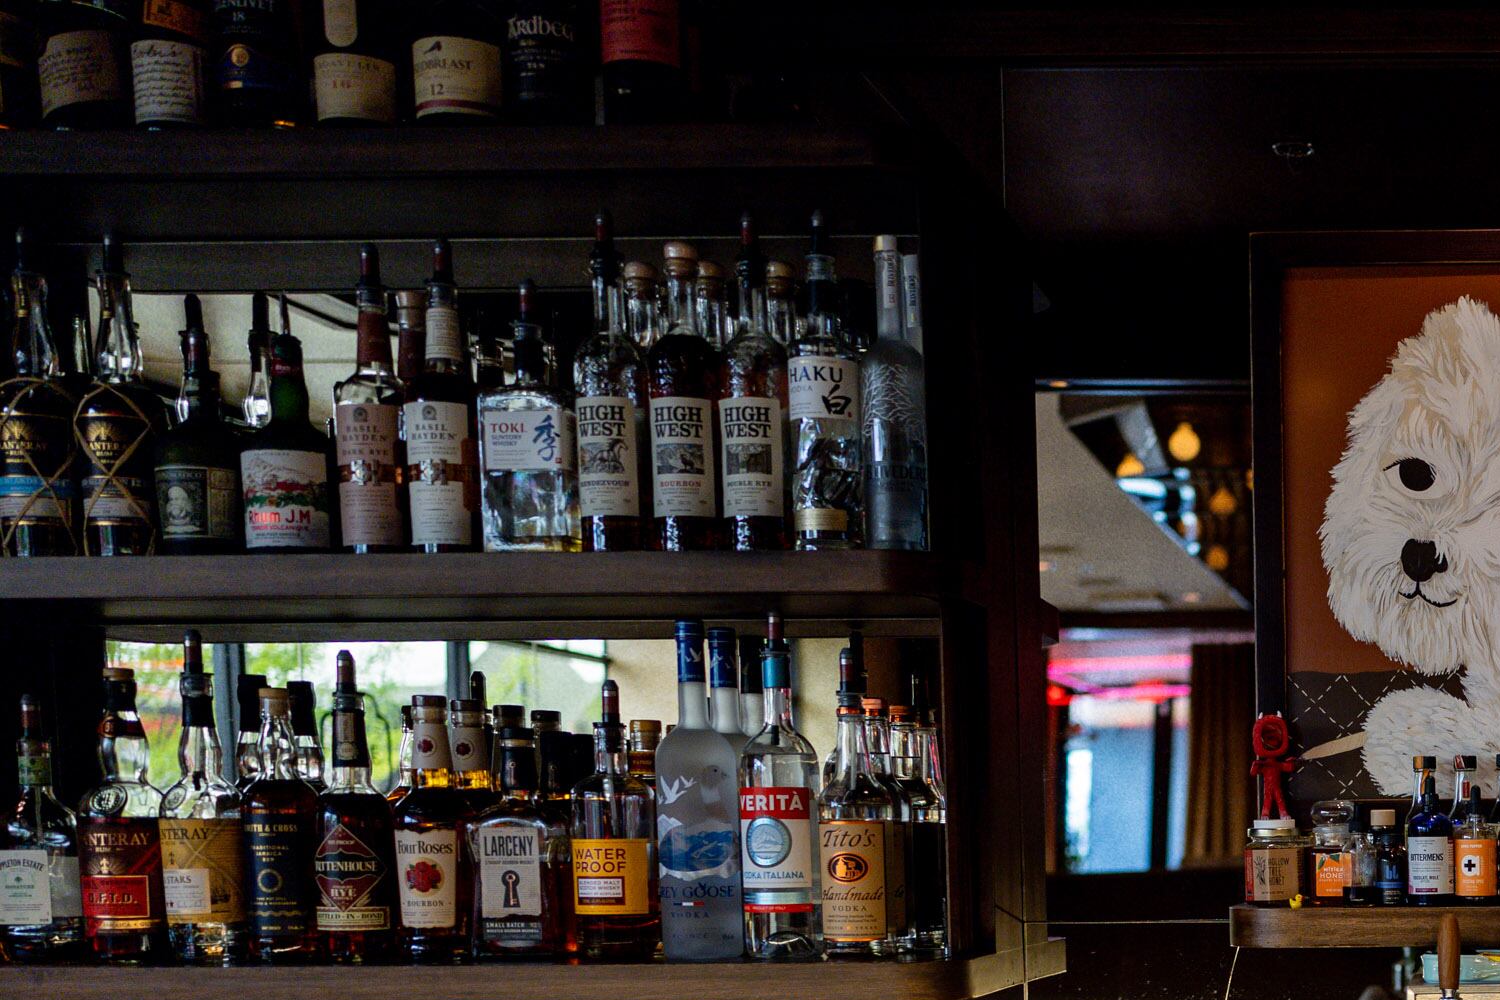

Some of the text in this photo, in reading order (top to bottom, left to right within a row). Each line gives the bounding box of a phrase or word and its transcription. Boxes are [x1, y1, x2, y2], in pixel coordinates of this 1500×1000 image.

[431, 84, 444, 96] 12
[789, 366, 843, 383] HAKU
[821, 384, 852, 416] 白
[578, 405, 625, 421] HIGH
[654, 406, 702, 422] HIGH
[724, 406, 770, 422] HIGH
[415, 423, 448, 432] BASIL
[490, 422, 525, 433] TOKI
[579, 422, 626, 437] WEST
[655, 423, 703, 438] WEST
[725, 423, 771, 438] WEST
[249, 510, 281, 524] Rhum
[273, 823, 299, 833] CROSS
[823, 827, 877, 848] Tito's
[398, 840, 454, 855] Four Roses
[484, 835, 534, 857] LARCENY
[575, 848, 626, 859] WATER
[575, 861, 627, 873] PROOF
[762, 871, 804, 879] ITALIANA
[330, 887, 356, 898] RYE
[682, 882, 736, 899] GOOSE
[822, 886, 884, 901] Handmade
